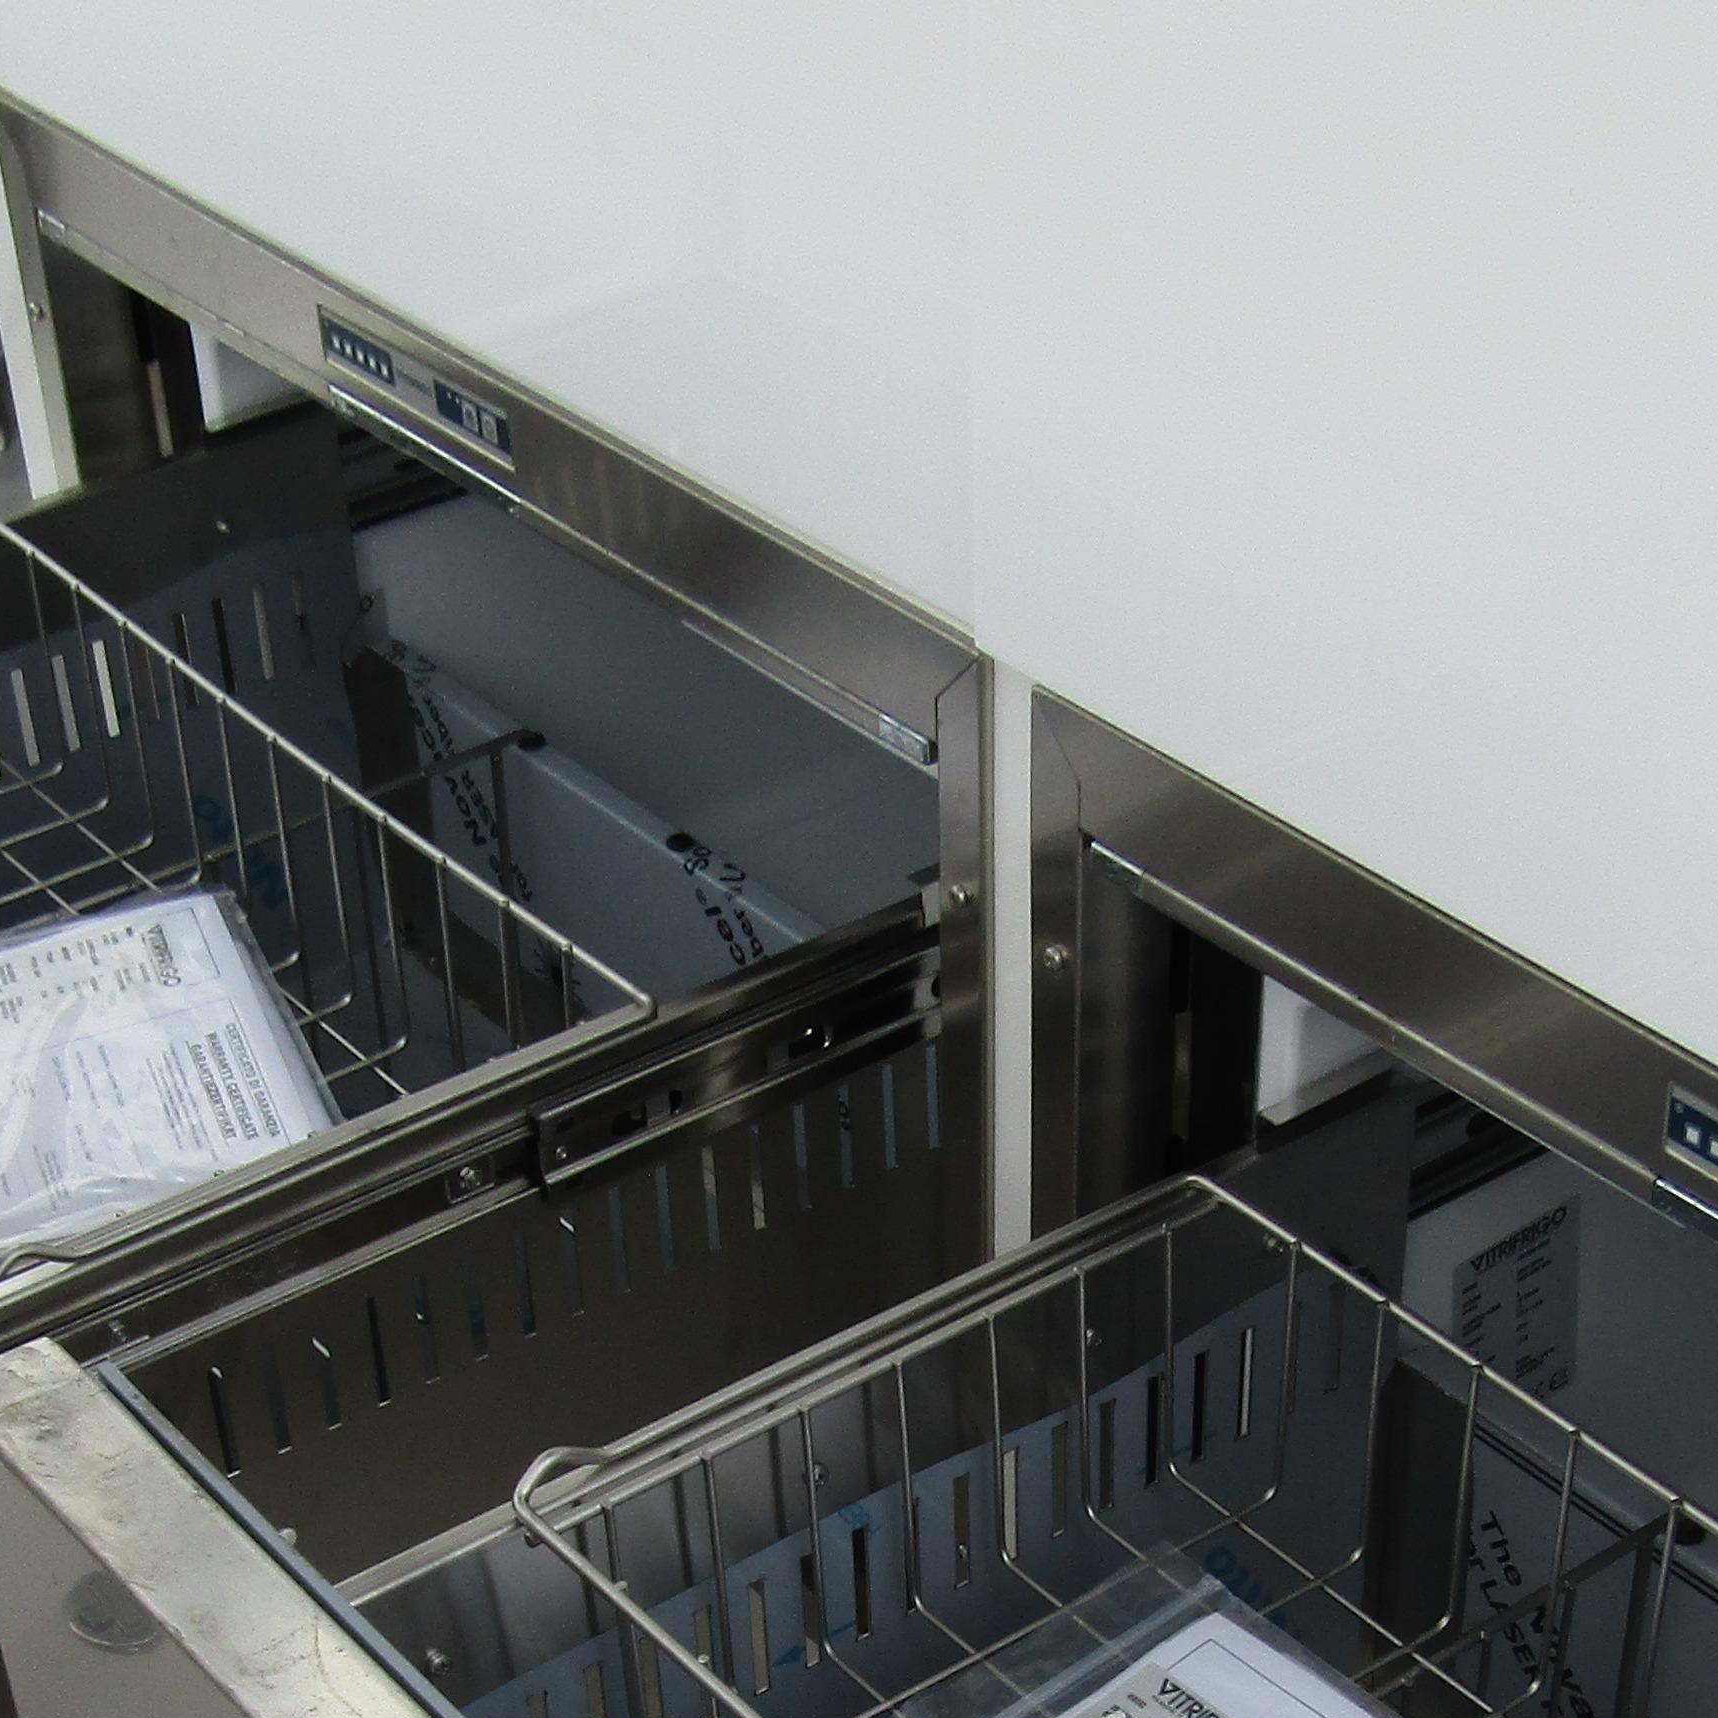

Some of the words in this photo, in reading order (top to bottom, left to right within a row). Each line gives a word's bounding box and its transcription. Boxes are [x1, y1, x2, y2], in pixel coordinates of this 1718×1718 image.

[224, 1021, 258, 1078] CERTIFICATO
[203, 1030, 236, 1082] WARRANTY
[223, 1081, 259, 1141] CERTIFICATE
[246, 1077, 262, 1090] DI
[251, 1089, 281, 1138] GARANZIA
[1470, 1203, 1567, 1273] VITRIFRIGO
[1474, 1510, 1525, 1589] The
